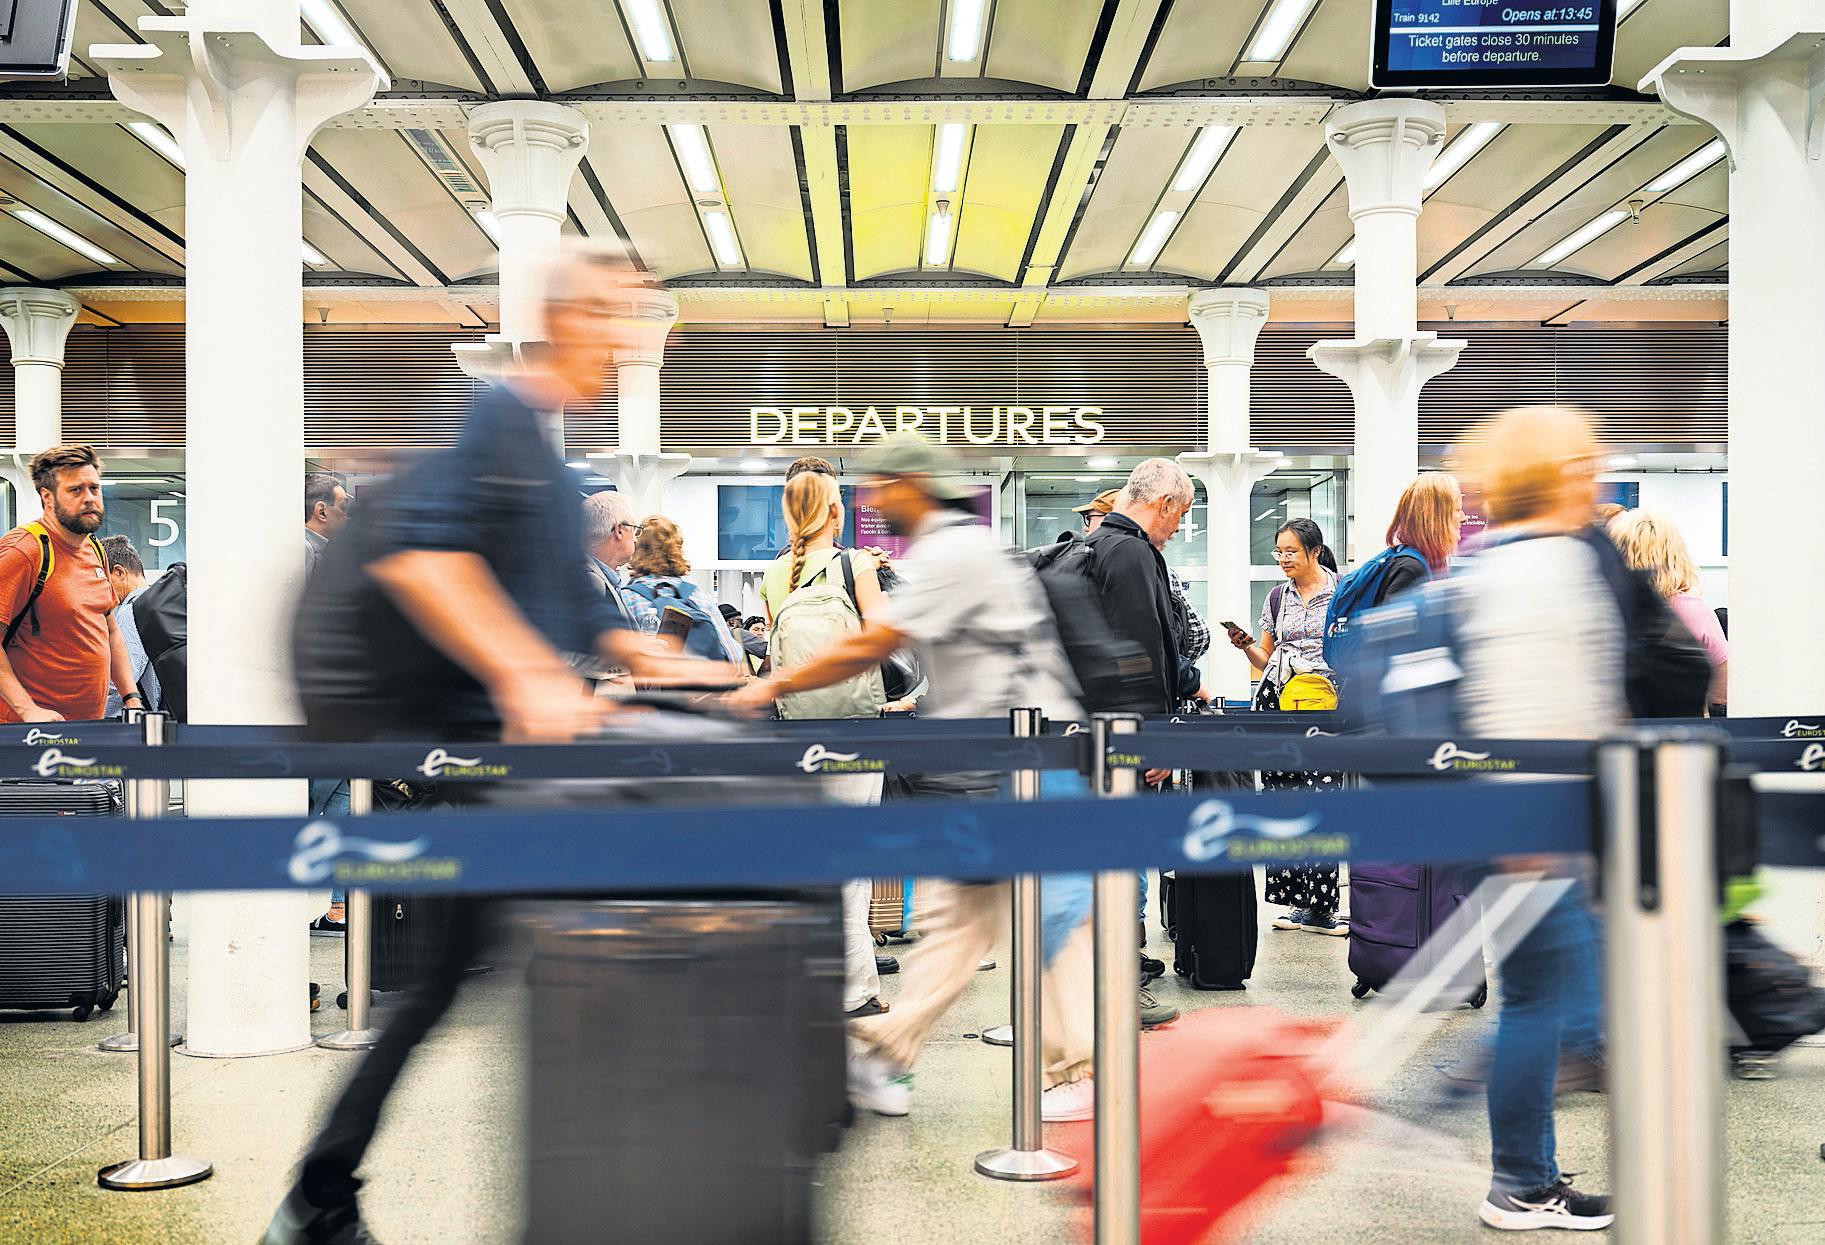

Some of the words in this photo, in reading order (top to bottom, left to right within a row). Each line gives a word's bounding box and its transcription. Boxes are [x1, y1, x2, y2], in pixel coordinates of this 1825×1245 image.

[1394, 13, 1415, 23] Train
[1418, 13, 1440, 23] 9142
[1501, 8, 1540, 22] Opens
[1408, 35, 1443, 47] Ticket
[1445, 36, 1478, 49] gates
[1481, 34, 1512, 46] close
[1515, 34, 1530, 46] 30
[1533, 34, 1579, 45] minutes
[1442, 50, 1479, 62] before
[1483, 50, 1542, 63] departure.
[749, 405, 1105, 445] DEPARTURES
[148, 499, 180, 547] 5
[39, 738, 79, 746] EUROSTAR
